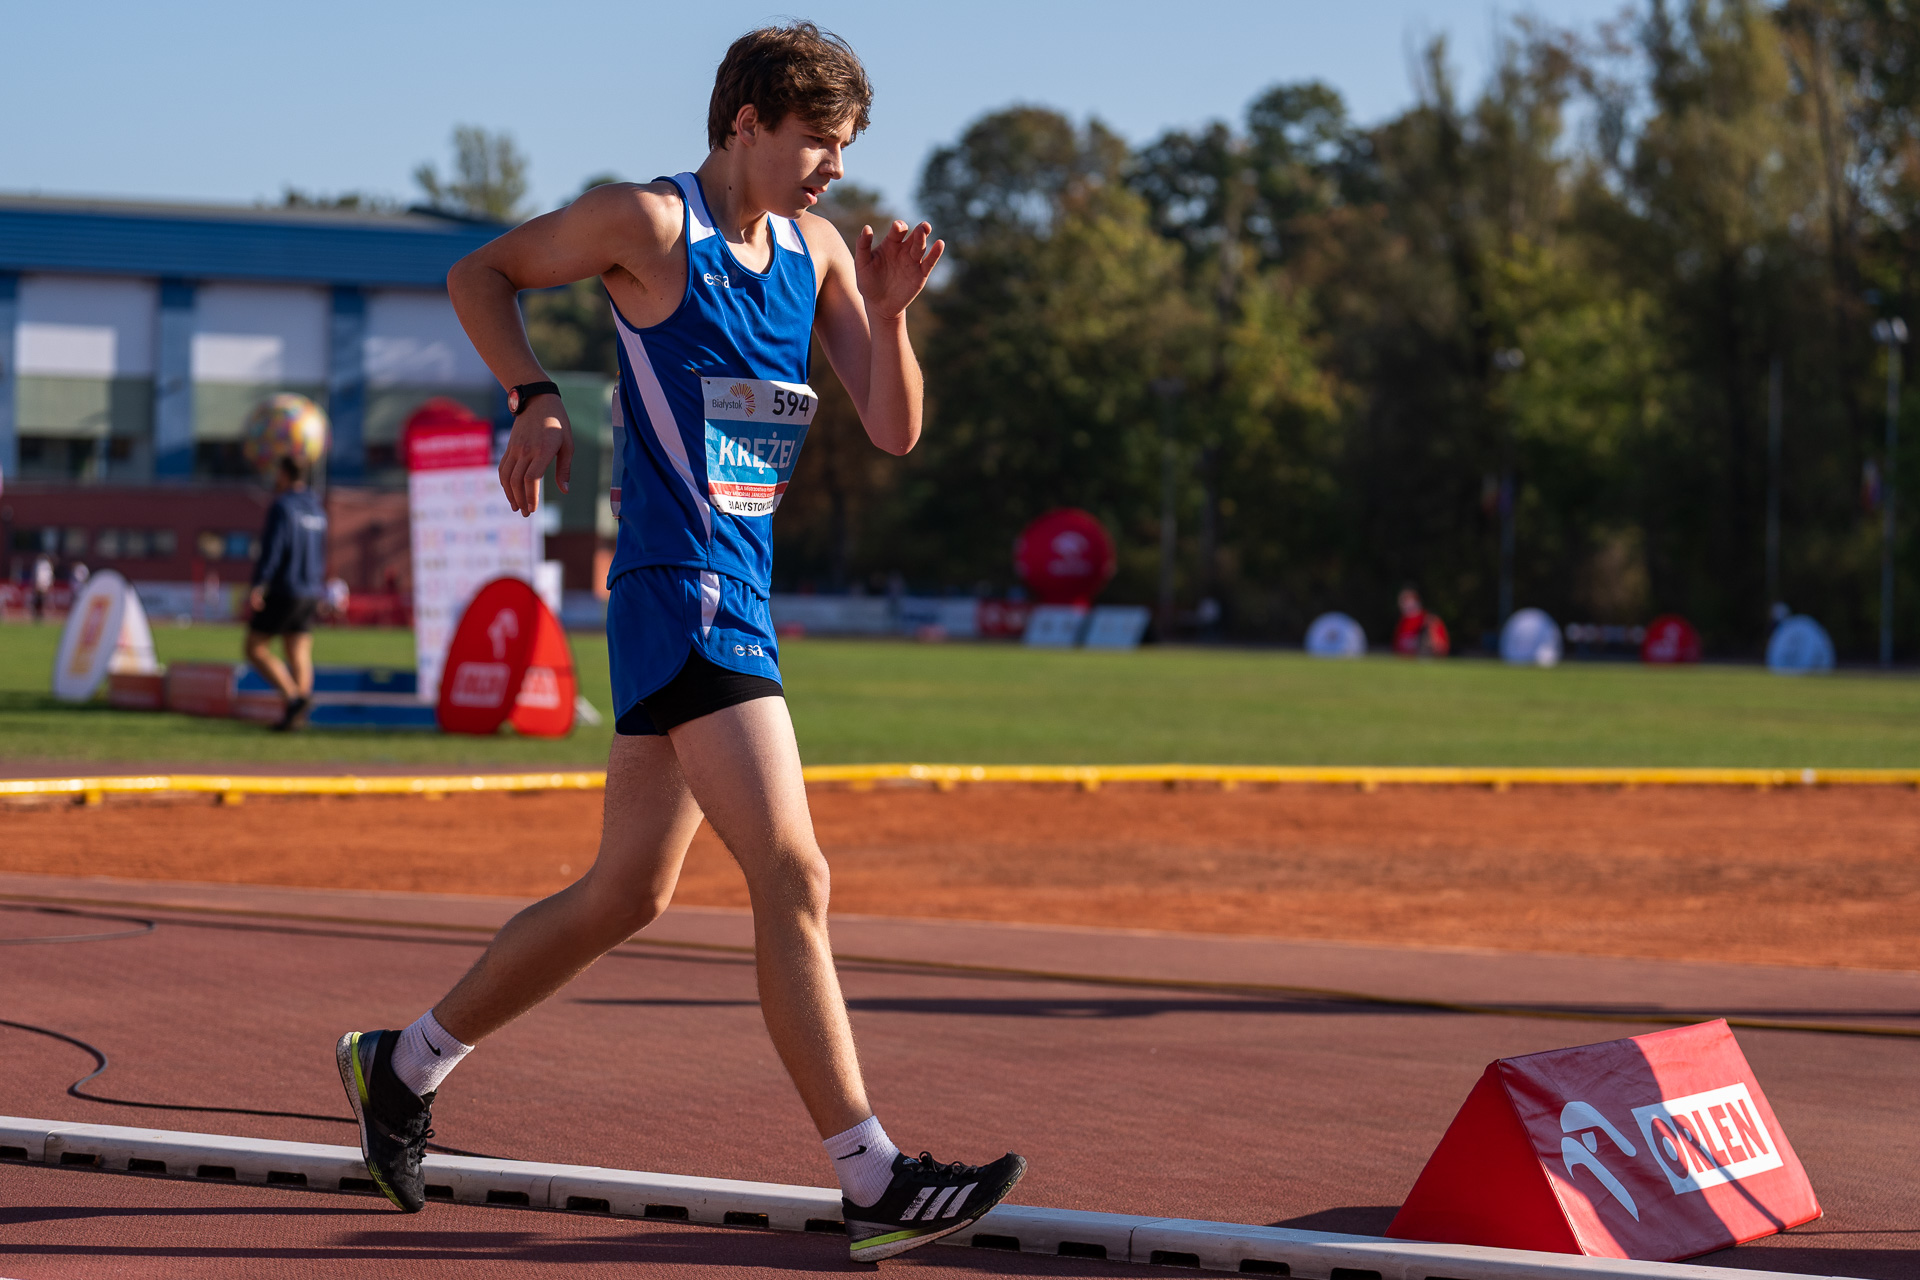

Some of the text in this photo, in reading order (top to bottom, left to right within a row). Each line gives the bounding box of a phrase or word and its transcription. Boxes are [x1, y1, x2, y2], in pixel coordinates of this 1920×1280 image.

[703, 272, 730, 289] esa
[712, 399, 743, 411] Białystok
[772, 390, 810, 417] 594
[732, 644, 764, 657] esa
[1650, 1098, 1770, 1180] ORLEN
